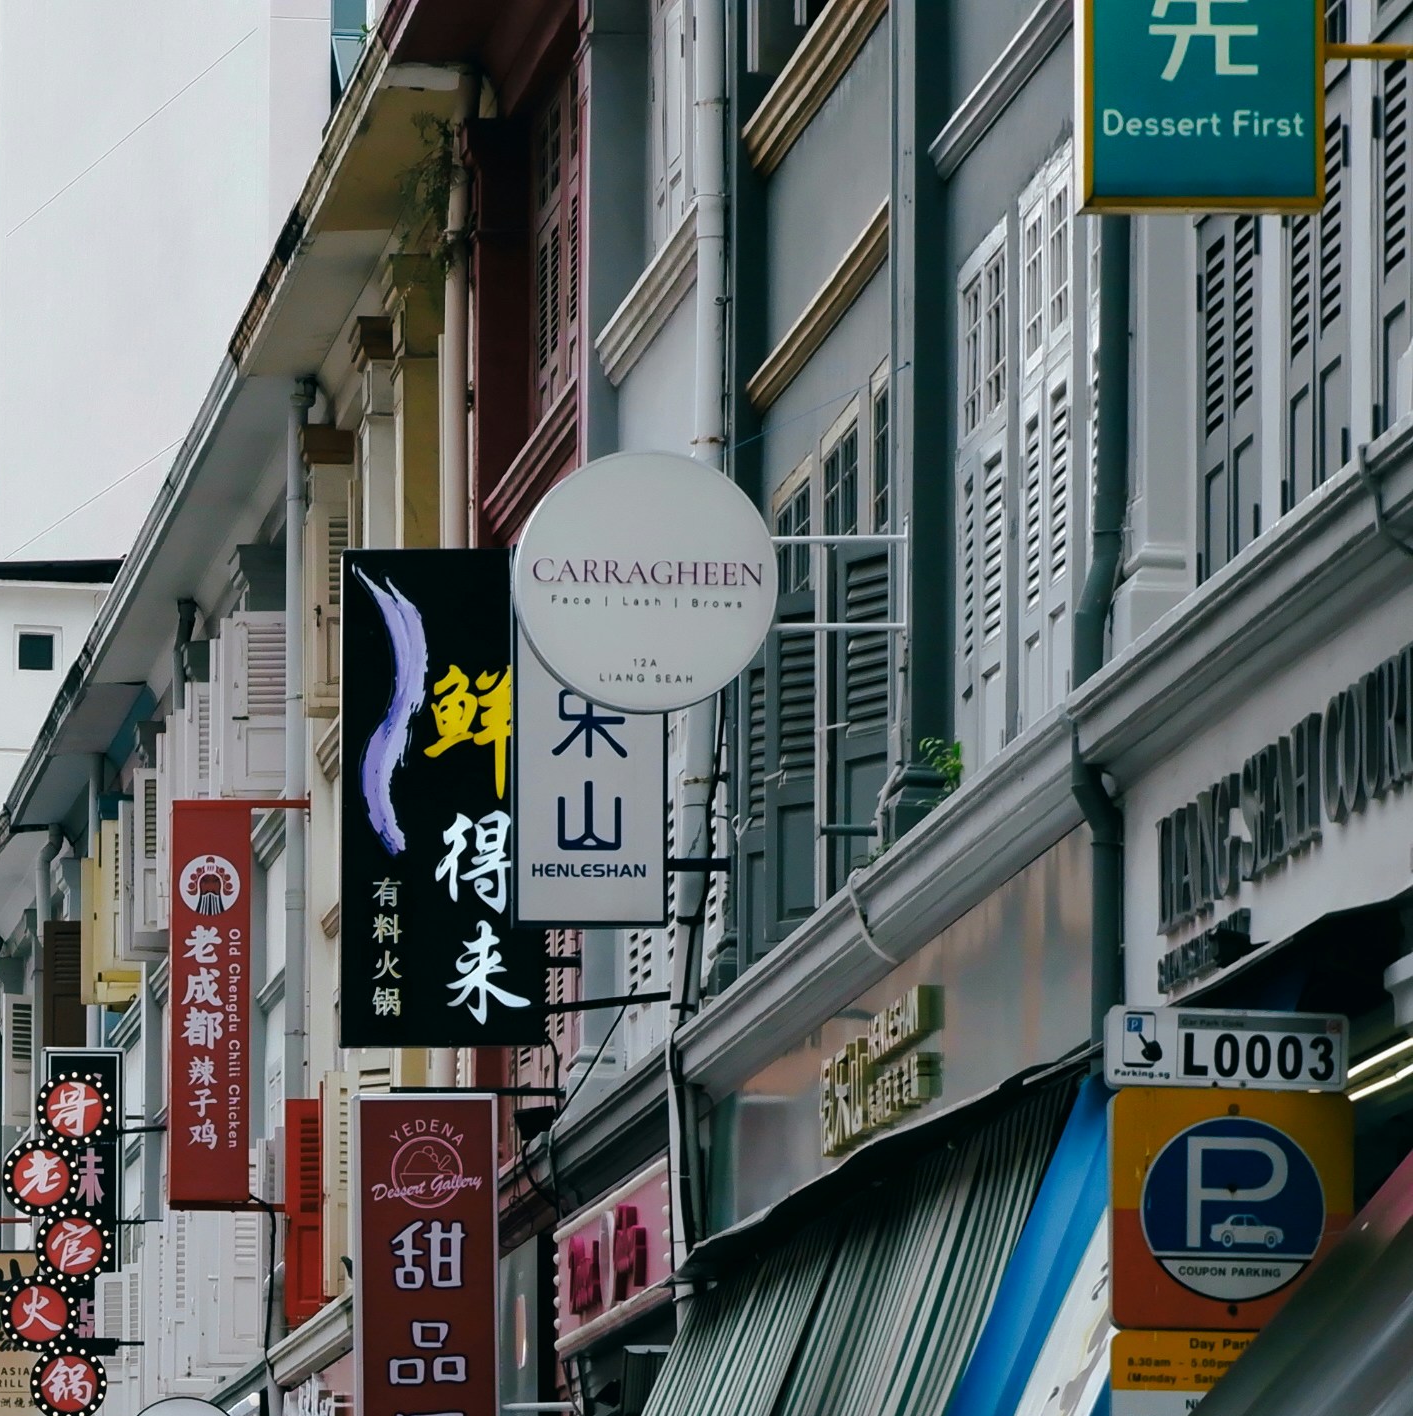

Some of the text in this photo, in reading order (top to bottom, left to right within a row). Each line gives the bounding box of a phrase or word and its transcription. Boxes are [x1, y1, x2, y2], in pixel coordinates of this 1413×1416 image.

[1148, 0, 1258, 81] 先
[1103, 108, 1304, 137] Dessert First
[532, 557, 763, 587] CARRAGHEEN
[551, 593, 743, 609] Face Lash Brows
[632, 658, 658, 668] 12A
[599, 671, 694, 685] LIANG SEAH
[552, 689, 627, 851] 乐山
[1156, 772, 1241, 936] LIANG
[1241, 712, 1323, 882] SEAH
[423, 664, 531, 1025] 鲜得来
[531, 863, 647, 879] HENLESHAN
[372, 878, 402, 1017] 有料火锅
[181, 925, 224, 1050] 老成都
[226, 928, 241, 1149] Old Chengdu Chili Chicken
[1183, 1032, 1334, 1081] L0003
[1114, 1069, 1170, 1080] Parking.sg
[188, 1056, 218, 1150] 辣子鸡
[389, 1119, 465, 1148] YEDENA
[371, 1173, 483, 1202] Dessert Gallery
[1186, 1136, 1288, 1248] P
[1178, 1265, 1282, 1279] COUPON PARKING
[1190, 1338, 1215, 1350] Day
[1127, 1373, 1177, 1384] (Monday
